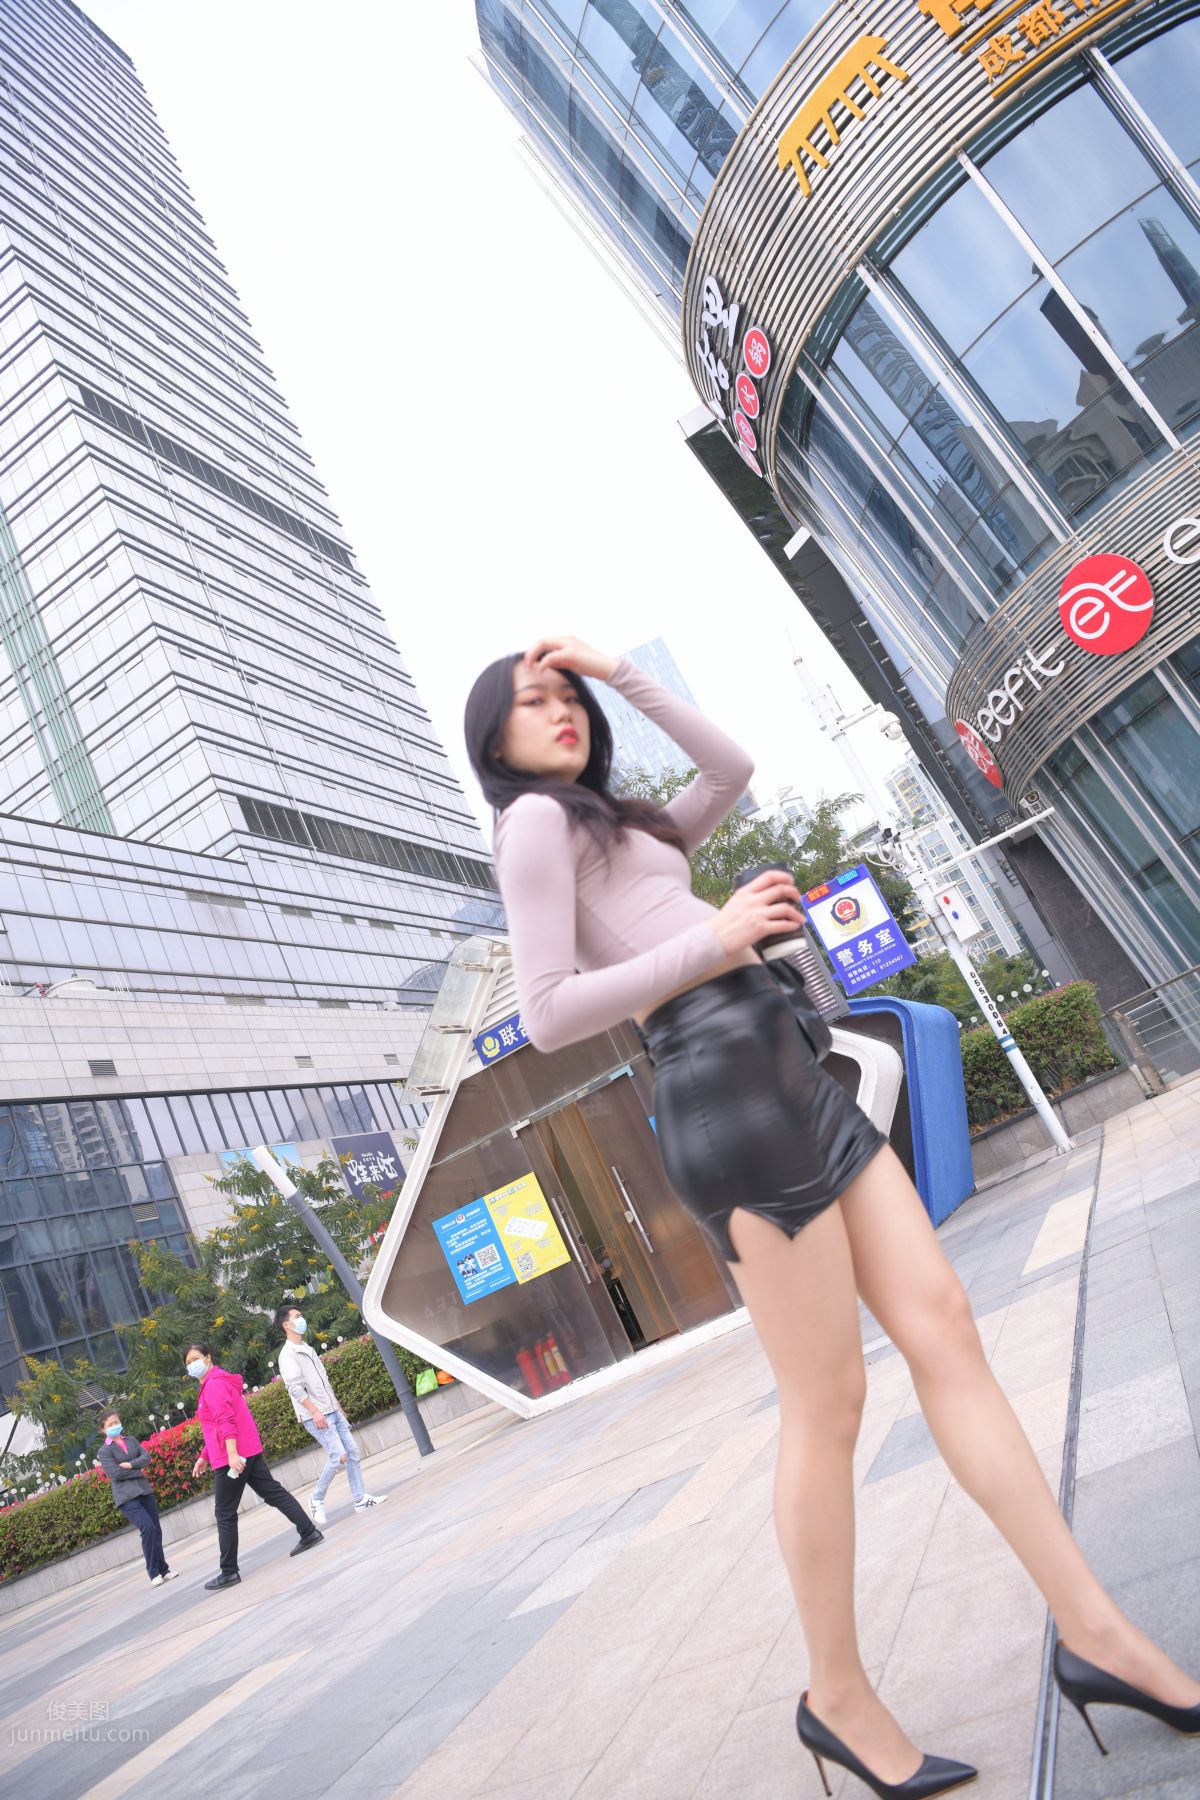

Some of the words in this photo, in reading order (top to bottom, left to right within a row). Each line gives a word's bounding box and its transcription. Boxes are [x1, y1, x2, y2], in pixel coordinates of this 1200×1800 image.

[977, 0, 1100, 84] 成都
[975, 645, 1065, 742] eefit
[835, 927, 895, 967] 警务室
